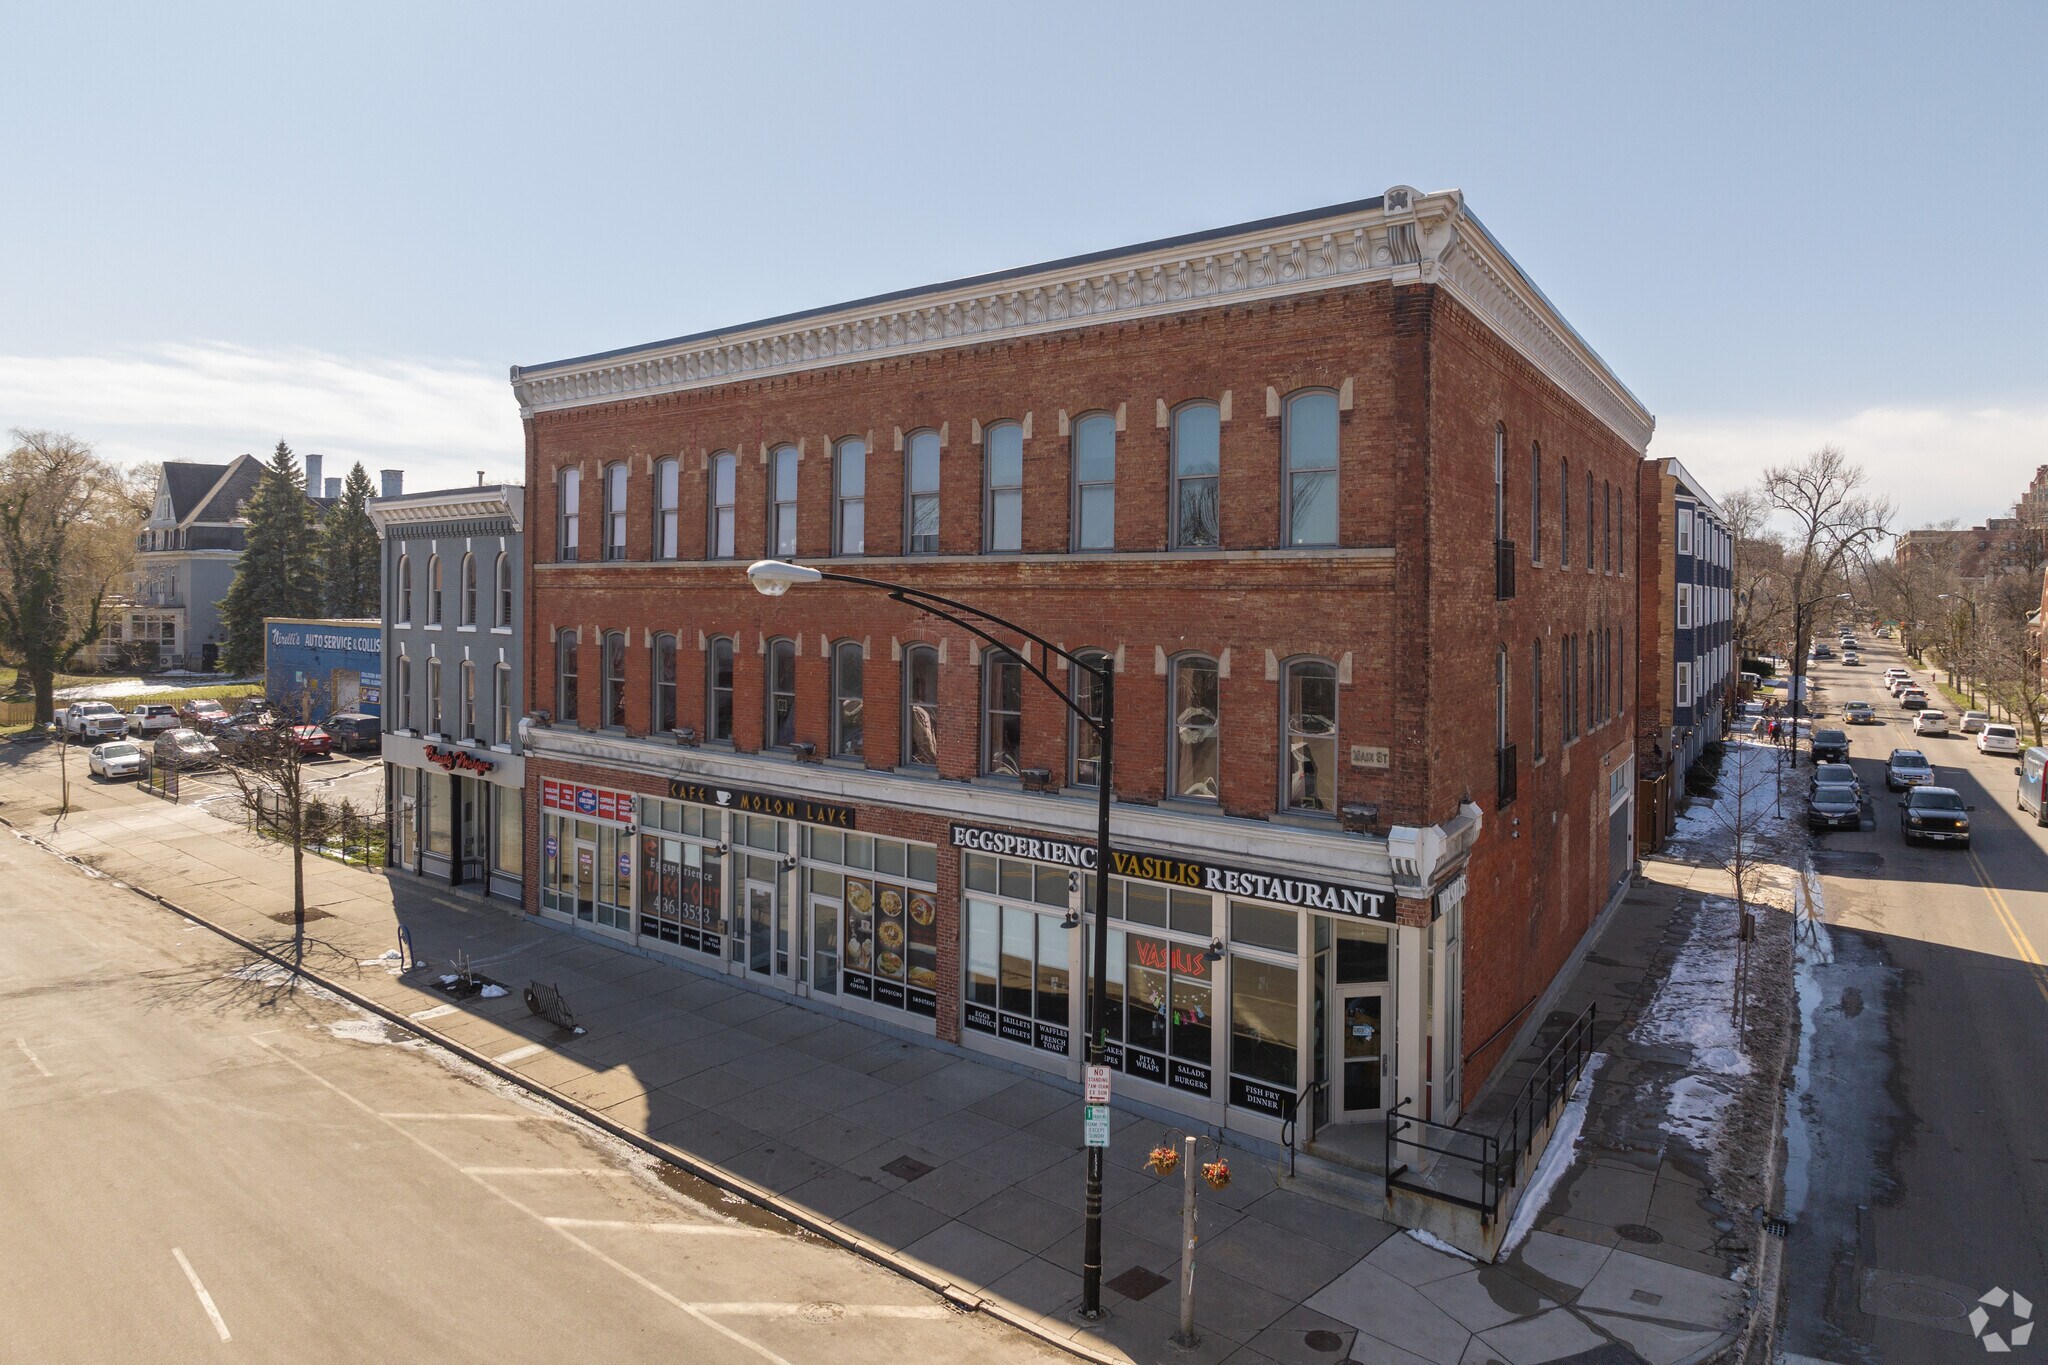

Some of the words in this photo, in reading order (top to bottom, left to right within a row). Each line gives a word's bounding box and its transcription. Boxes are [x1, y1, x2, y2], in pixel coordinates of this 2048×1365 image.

[305, 634, 323, 648] AUTO
[323, 635, 352, 651] SERVICE
[352, 639, 358, 650] &
[423, 744, 456, 771] Beauty
[670, 783, 705, 802] CAFE
[740, 794, 796, 816] MOLON
[806, 804, 847, 826] LAVE
[650, 858, 713, 881] Eggsperience
[644, 870, 720, 912] TAKE-OUT
[1112, 852, 1200, 887] VASILIS
[1205, 867, 1386, 918] RESTAURANT
[653, 895, 711, 924] 436-3533
[1136, 939, 1206, 976] VASILIS
[853, 977, 865, 985] LATTE
[879, 987, 903, 998] CAPPUCCINO
[912, 996, 936, 1008] SMOOTHIES
[967, 1015, 997, 1029] BENEDICT
[975, 1010, 990, 1020] EGGS
[1003, 1016, 1031, 1029] SKILLETS
[1002, 1026, 1031, 1040] OMELETS
[1040, 1025, 1068, 1038] WAFFLES
[1040, 1035, 1066, 1047] FRENCH
[1043, 1041, 1064, 1052] TOAST
[1136, 1060, 1160, 1073] WRAPS
[1139, 1054, 1156, 1065] PITA
[1177, 1065, 1205, 1079] SALADS
[1175, 1075, 1208, 1090] BURGERS
[1245, 1085, 1263, 1097] FISH
[1264, 1089, 1280, 1101] FRY
[1247, 1094, 1279, 1110] DINNER
